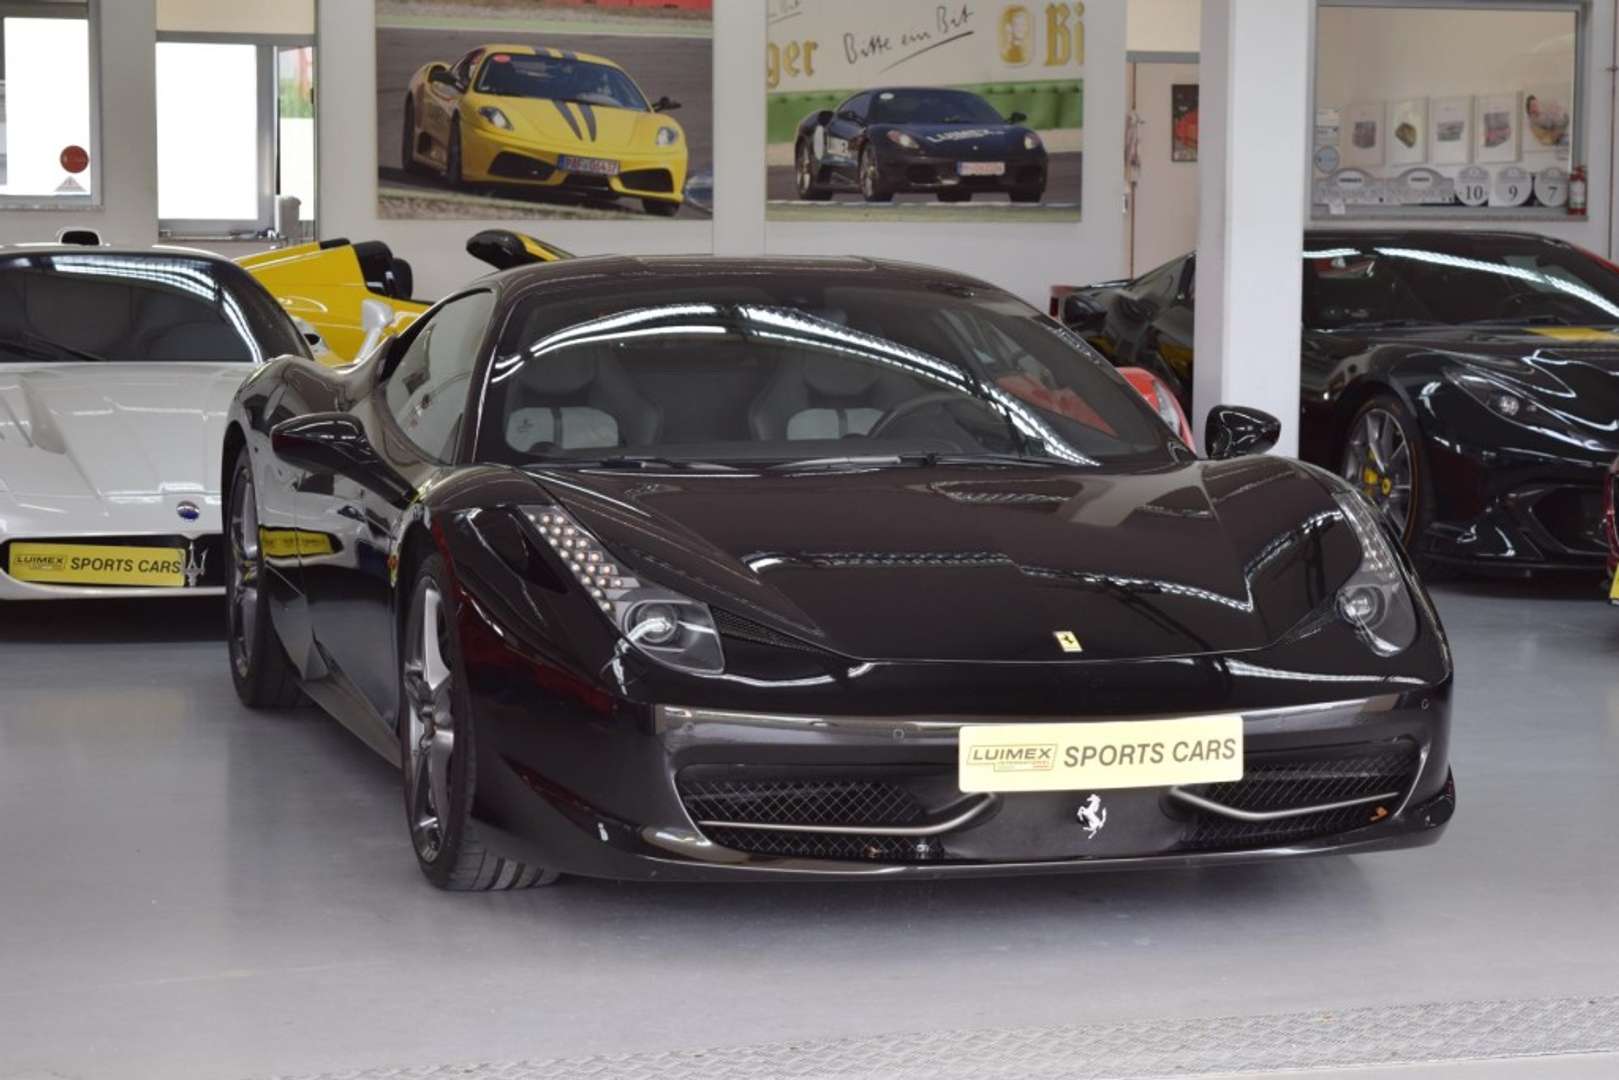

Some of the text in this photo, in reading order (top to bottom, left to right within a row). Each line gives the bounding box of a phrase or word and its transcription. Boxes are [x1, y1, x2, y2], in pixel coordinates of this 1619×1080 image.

[768, 40, 818, 88] ger
[1465, 185, 1483, 201] 10
[1508, 185, 1518, 201] 9
[1547, 186, 1558, 201] 7
[70, 556, 134, 572] SPORTS
[138, 560, 182, 574] CARS
[972, 748, 1053, 761] LUIMEX
[1063, 738, 1236, 768] SPORTS CARS
